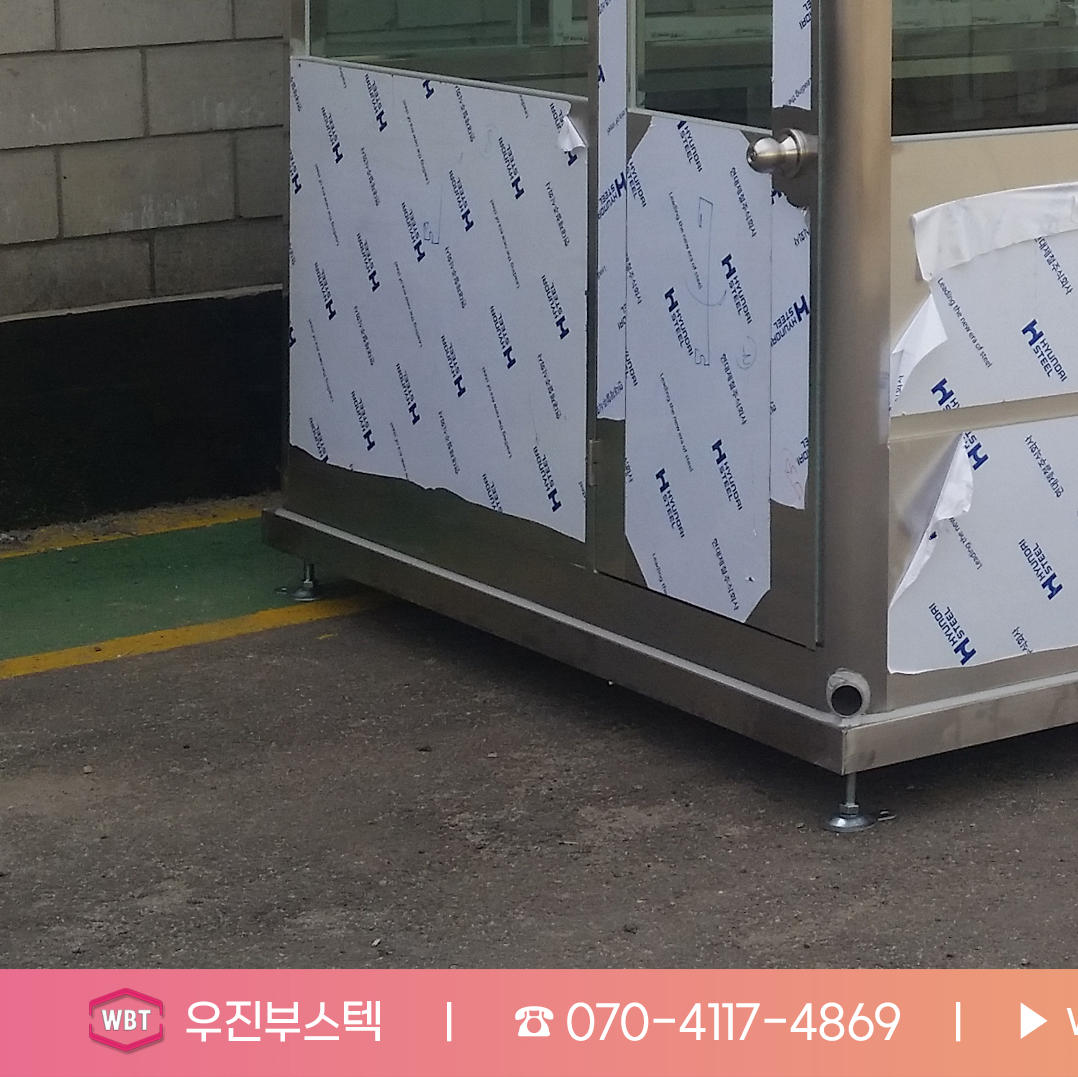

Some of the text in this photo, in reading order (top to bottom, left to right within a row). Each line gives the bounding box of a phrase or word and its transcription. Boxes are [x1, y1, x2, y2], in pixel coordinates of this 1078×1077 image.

[498, 136, 516, 181] HYUNDAI
[506, 144, 520, 177] STEEL
[680, 130, 693, 164] STEEL
[684, 124, 703, 172] HYUNDAI
[449, 170, 466, 214] HYUNDAI
[456, 176, 470, 210] STEEL
[599, 183, 616, 205] STEEL
[402, 202, 418, 245] HYUNDAI
[408, 208, 421, 240] STEEL
[540, 274, 560, 321] HYUNDAI
[551, 282, 564, 317] STEEL
[728, 281, 742, 316] STEEL
[732, 276, 752, 324] HYUNDAI
[490, 306, 507, 350] HYUNDAI
[497, 312, 510, 346] STEEL
[670, 314, 685, 348] STEEL
[674, 307, 694, 356] HYUNDAI
[773, 307, 795, 329] STEEL
[441, 335, 457, 378] HYUNDAI
[448, 342, 460, 374] STEEL
[1032, 345, 1054, 378] STEEL
[1039, 338, 1068, 382] HYUNDAI
[533, 446, 550, 492] HYUNDAI
[542, 454, 555, 488] STEEL
[719, 466, 733, 502] STEEL
[723, 461, 744, 511] HYUNDAI
[662, 494, 677, 530] STEEL
[666, 490, 686, 538] HYUNDAI
[1018, 538, 1048, 584] HYUNDAI
[1032, 542, 1055, 576] STEEL
[927, 602, 959, 648] HYUNDAI
[944, 606, 968, 641] STEEL
